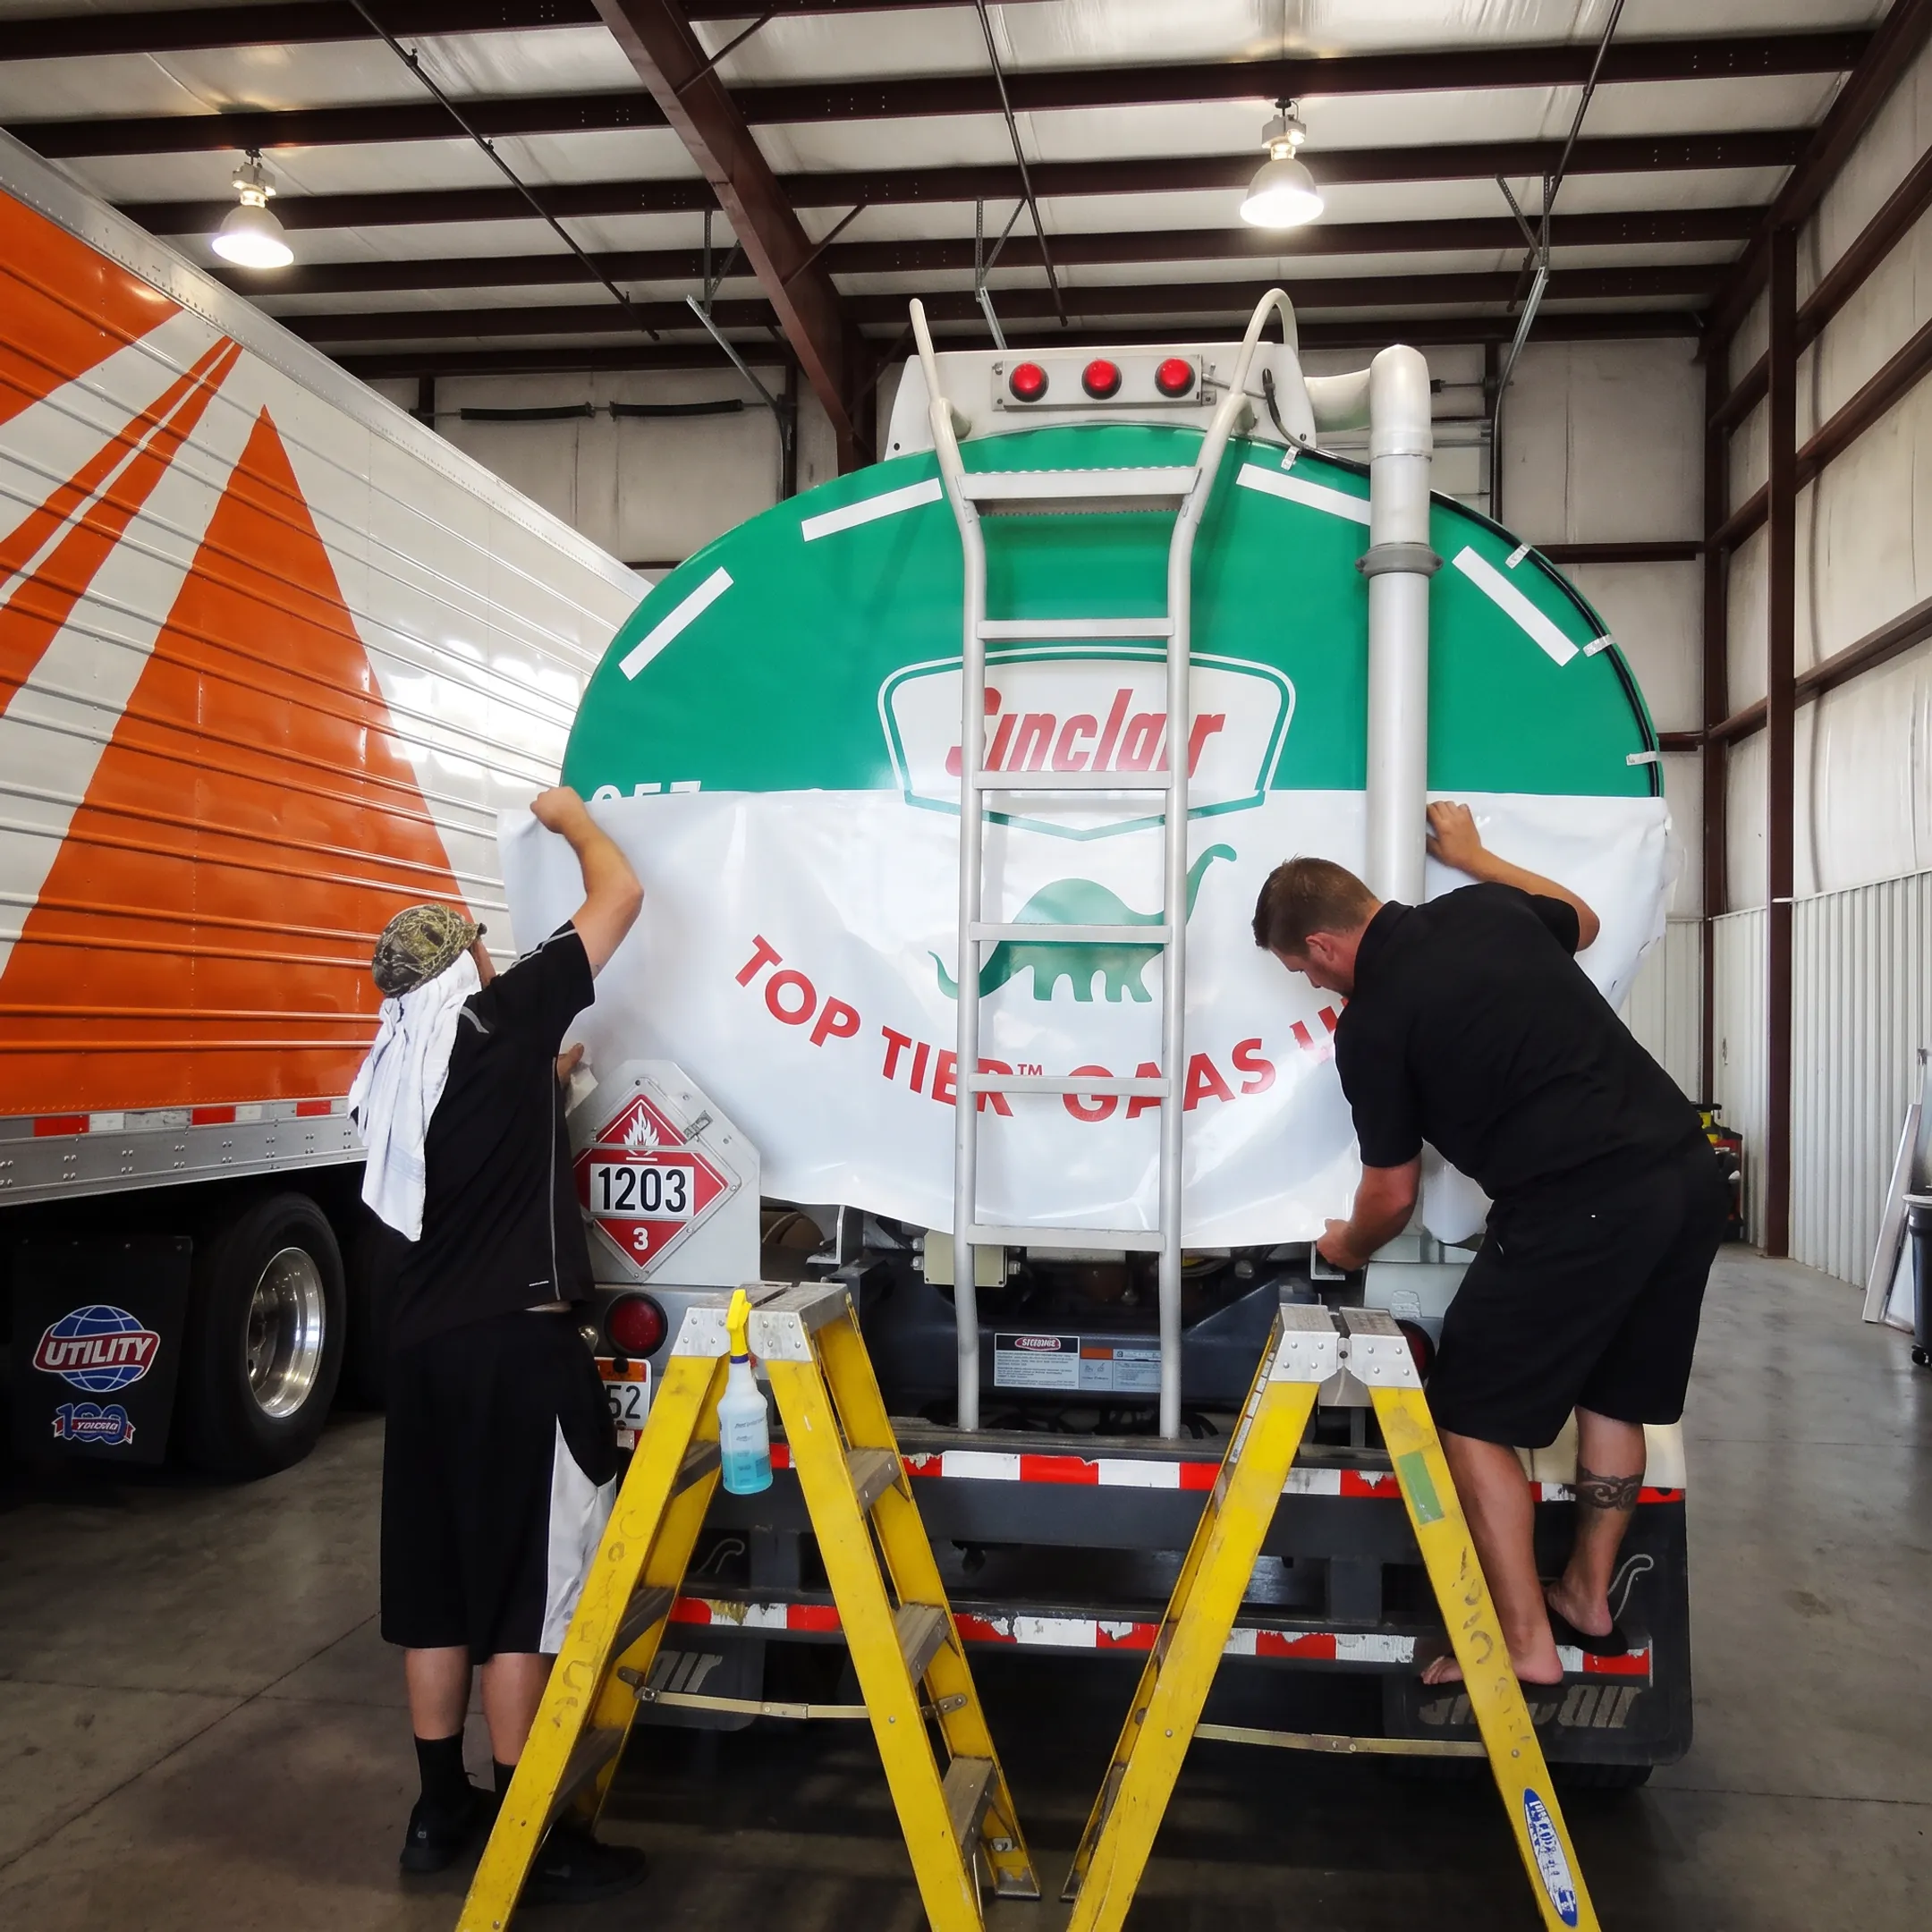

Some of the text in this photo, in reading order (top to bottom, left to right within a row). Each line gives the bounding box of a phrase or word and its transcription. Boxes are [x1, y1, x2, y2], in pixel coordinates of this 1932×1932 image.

[945, 687, 1226, 779] Sinclar
[735, 934, 861, 1047] TOP
[597, 1166, 687, 1213] 1203
[632, 1226, 649, 1251] 3
[45, 1337, 153, 1366] UTILITY
